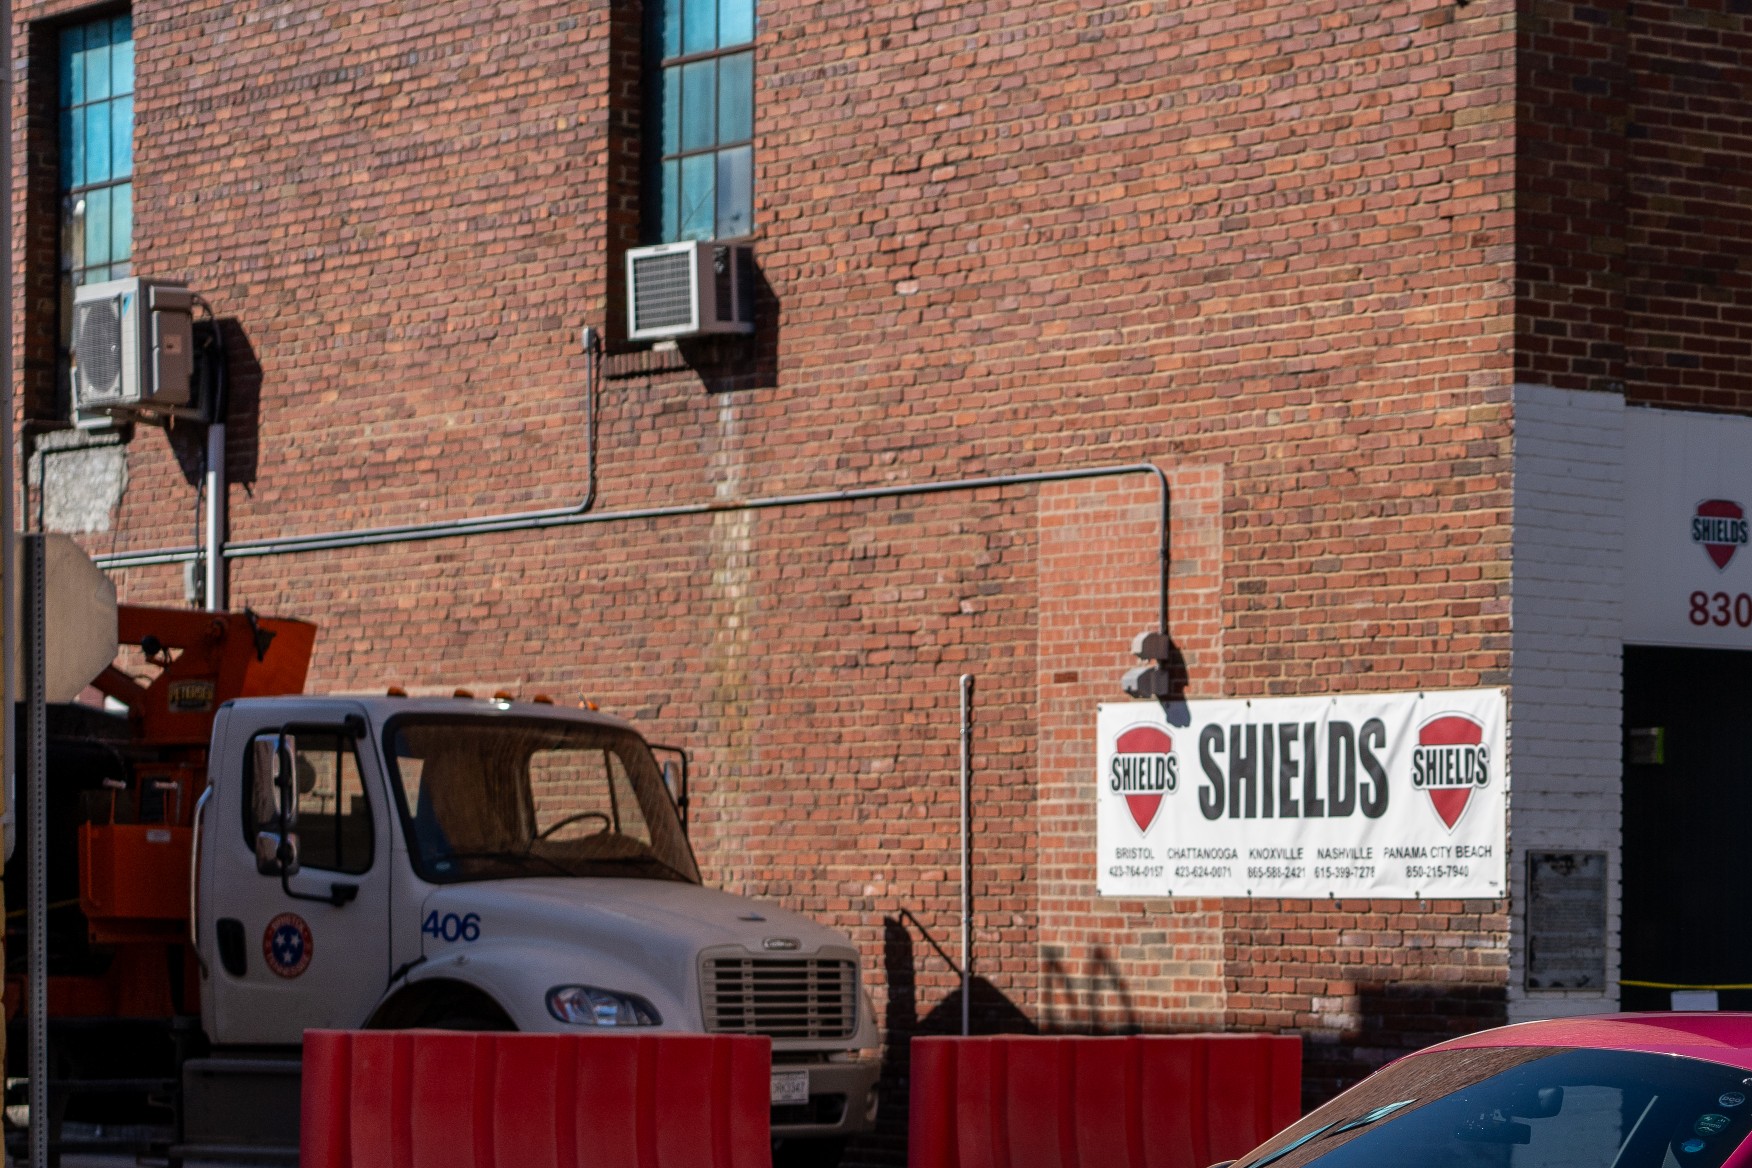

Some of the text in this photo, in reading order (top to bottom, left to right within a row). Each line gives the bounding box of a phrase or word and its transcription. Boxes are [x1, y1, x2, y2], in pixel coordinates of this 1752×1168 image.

[1693, 518, 1747, 543] SHIELDS
[1689, 590, 1752, 627] 830
[1111, 756, 1177, 792] SHIELDS
[1198, 718, 1389, 820] SHIELDS
[1412, 747, 1488, 786] SHIELDS
[1115, 848, 1155, 859] BRISTOL
[1168, 848, 1238, 859] CHATTANOOGA
[1249, 847, 1303, 859] KNOXVILLE
[1317, 847, 1373, 859] NASHVILLE
[1383, 845, 1492, 858] PANAMA CITY BEACH
[422, 910, 480, 941] 406
